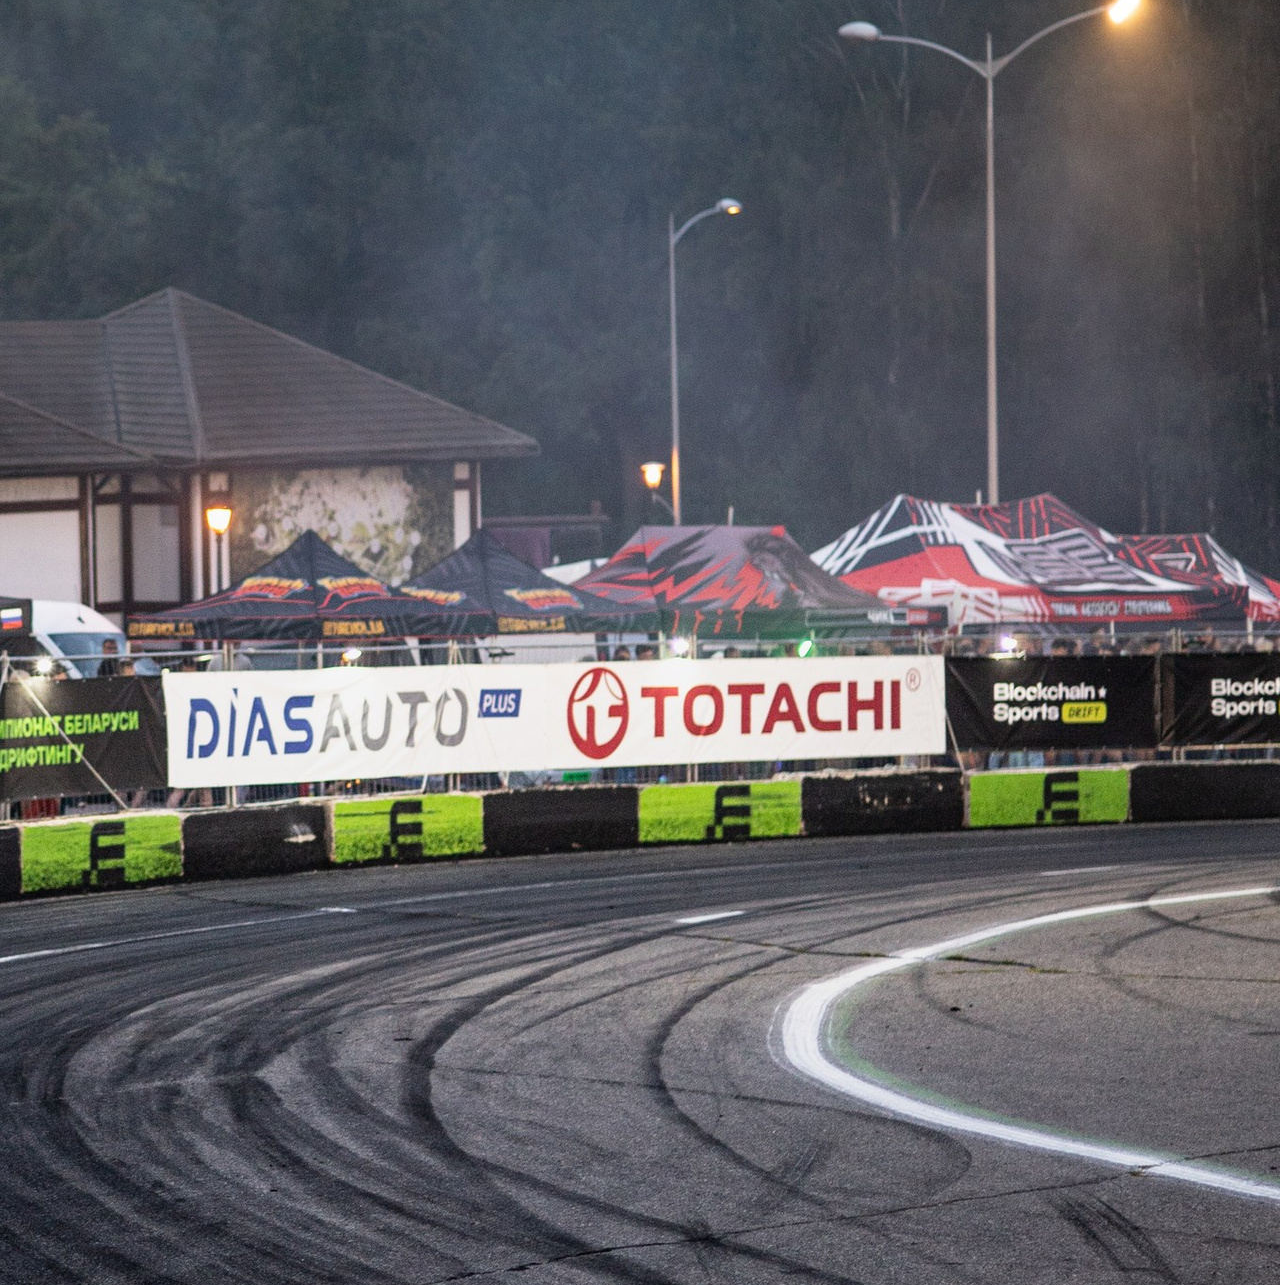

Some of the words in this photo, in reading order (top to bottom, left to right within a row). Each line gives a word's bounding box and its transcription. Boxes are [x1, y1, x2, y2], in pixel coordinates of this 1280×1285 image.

[993, 682, 1096, 701] Blockchain
[482, 694, 517, 714] PLUS
[641, 680, 901, 738] TOTACHI
[993, 702, 1060, 724] Sports
[1210, 697, 1277, 719] Sports
[64, 710, 140, 733] БЕЛАРУСИ
